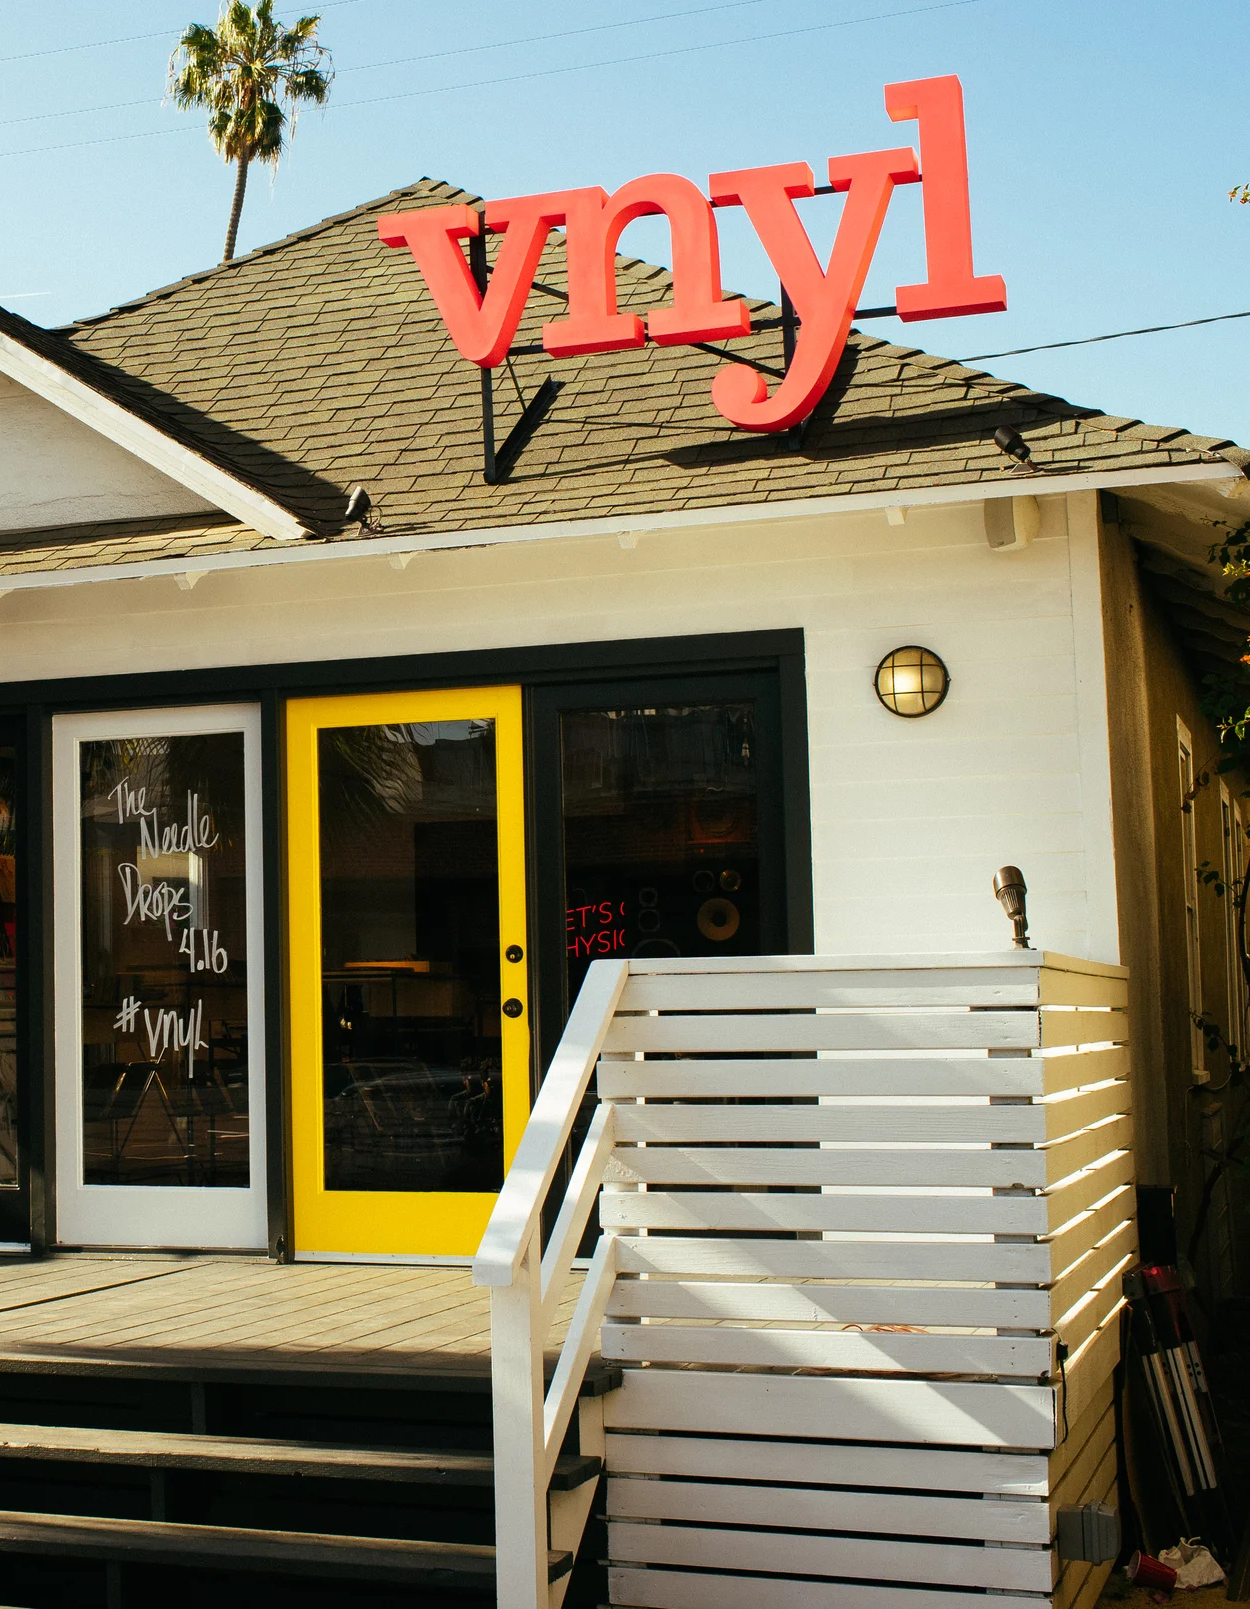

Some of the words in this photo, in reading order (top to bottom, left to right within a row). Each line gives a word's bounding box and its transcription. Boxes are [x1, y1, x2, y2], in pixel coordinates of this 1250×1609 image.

[377, 74, 1007, 432] vnyl
[108, 776, 157, 824] The
[140, 789, 219, 860] Needle
[178, 926, 228, 974] 4.16
